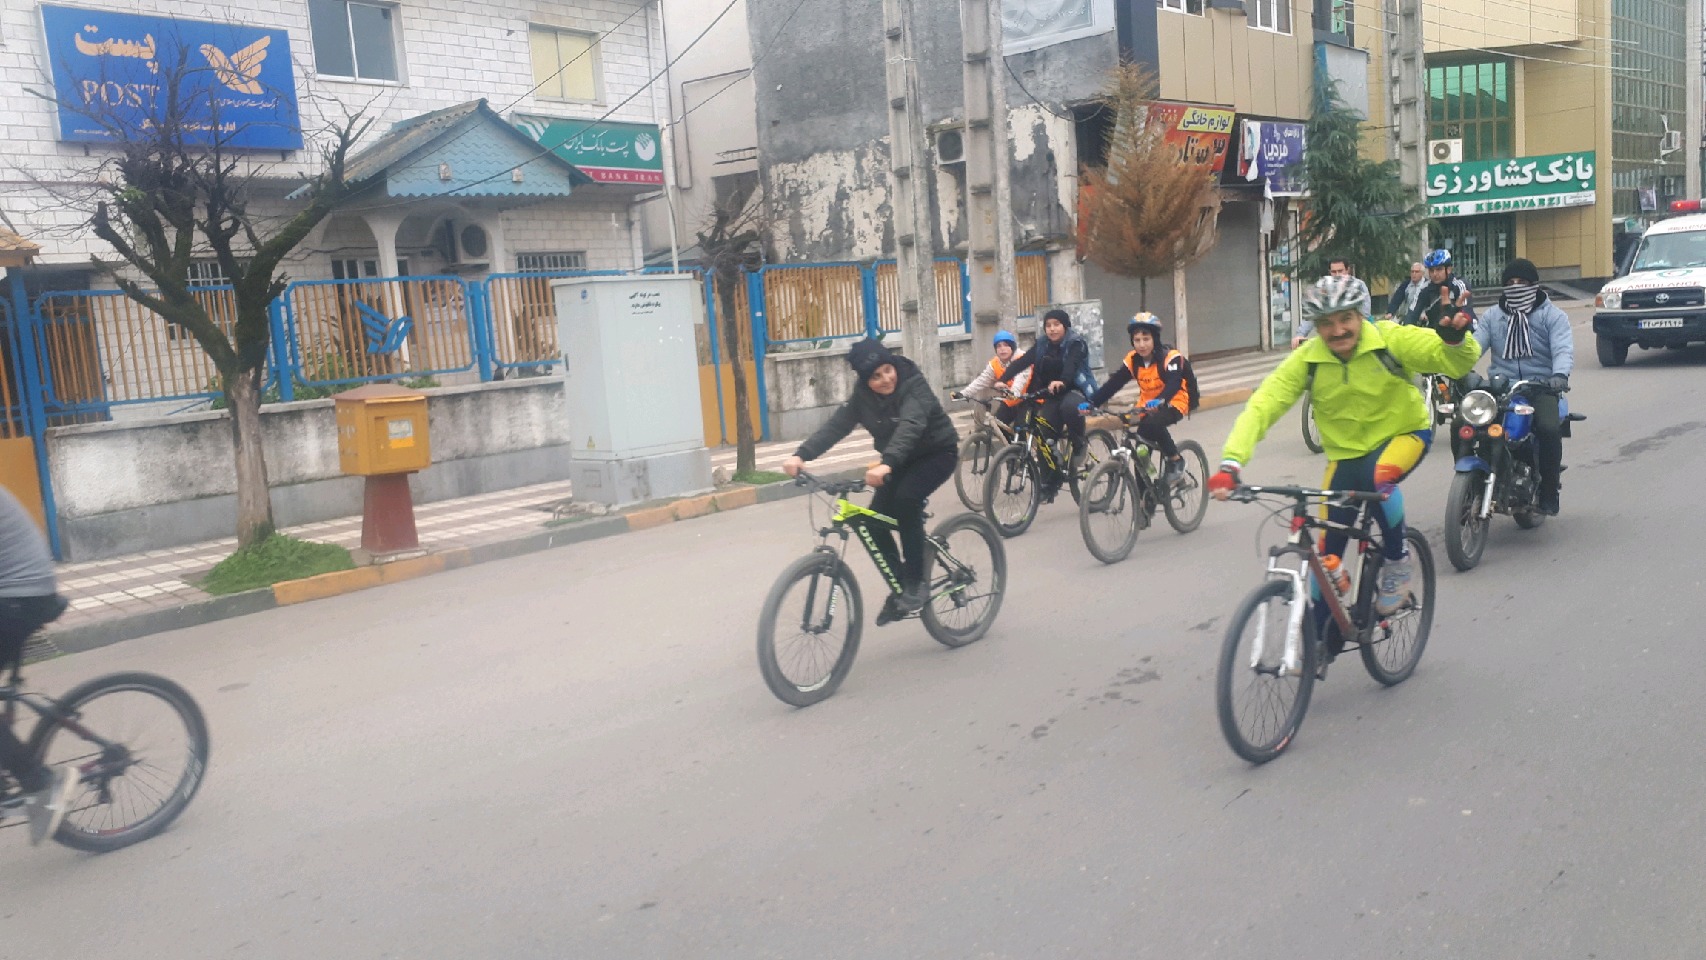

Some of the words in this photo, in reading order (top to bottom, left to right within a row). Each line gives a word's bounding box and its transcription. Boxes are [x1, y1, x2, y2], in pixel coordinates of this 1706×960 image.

[75, 24, 159, 74] پست
[82, 79, 161, 109] POST
[1183, 110, 1208, 128] خانگی
[1208, 114, 1230, 130] لوازم
[583, 130, 608, 156] بانک
[605, 139, 629, 158] پست
[600, 172, 629, 180] BANK
[1426, 159, 1537, 197] کشاورزی
[1536, 155, 1594, 189] بانک
[1475, 196, 1561, 212] KESHAVARZI
